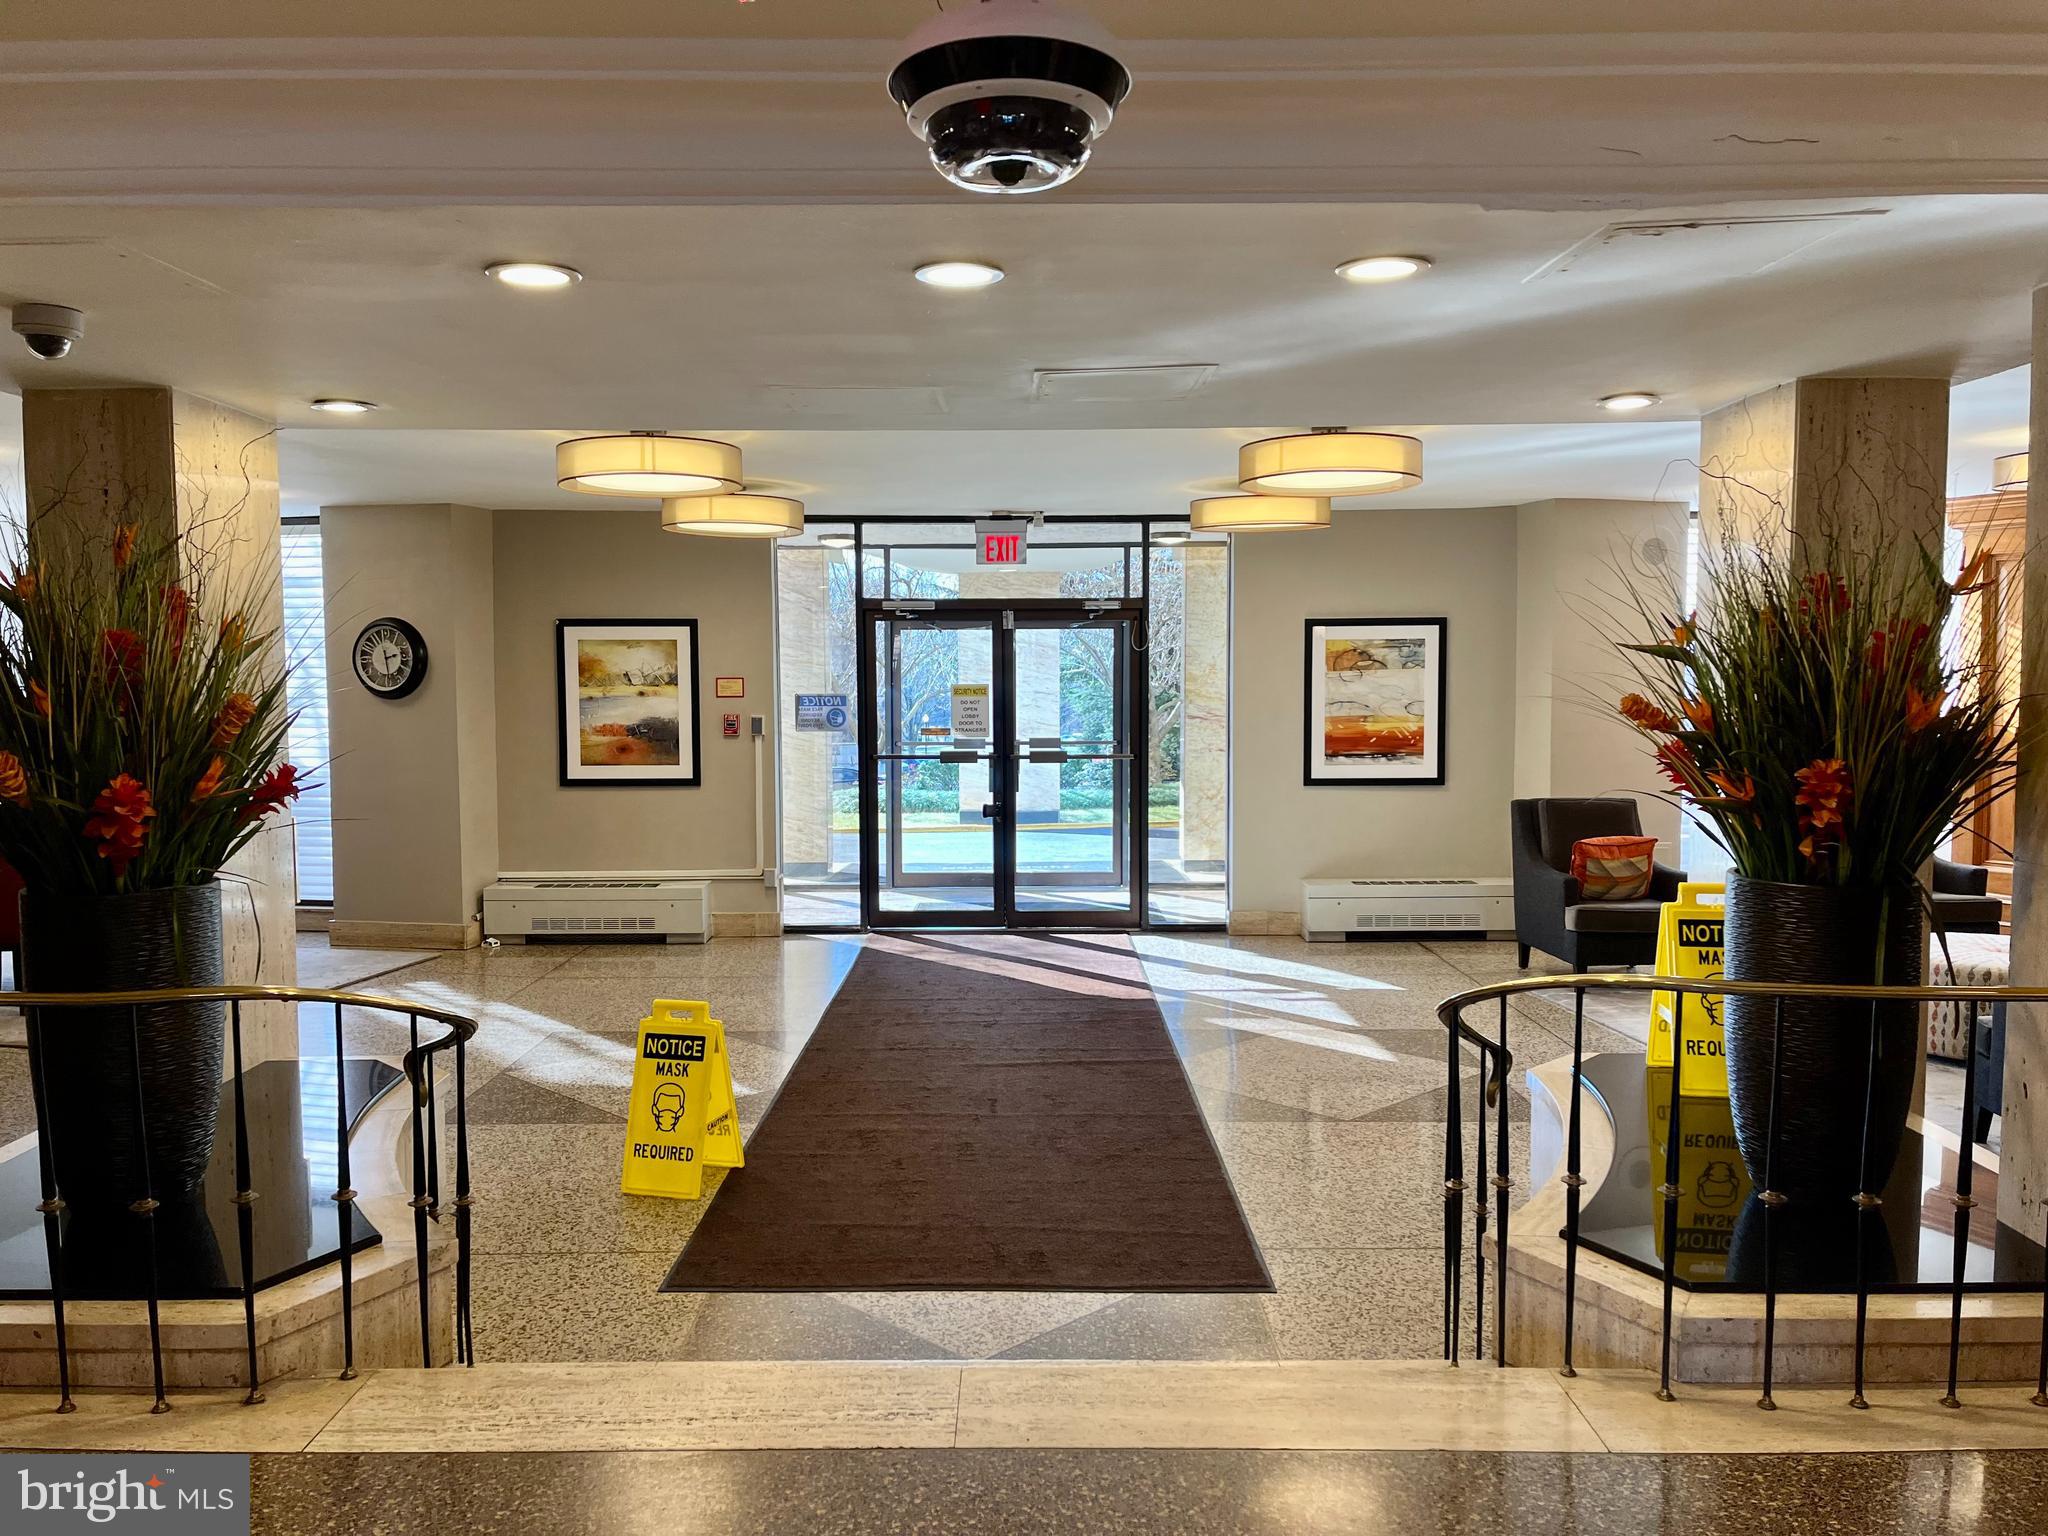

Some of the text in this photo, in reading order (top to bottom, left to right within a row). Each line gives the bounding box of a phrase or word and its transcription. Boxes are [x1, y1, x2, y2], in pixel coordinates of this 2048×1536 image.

[986, 535, 1019, 562] EXIT
[1682, 924, 1722, 942] NOT
[1698, 949, 1724, 966] MA
[646, 1037, 703, 1057] NOTICE
[1686, 1039, 1726, 1057] REQU
[655, 1061, 690, 1078] MASK
[707, 1112, 729, 1131] CAUTION
[633, 1143, 694, 1162] REQUIRED
